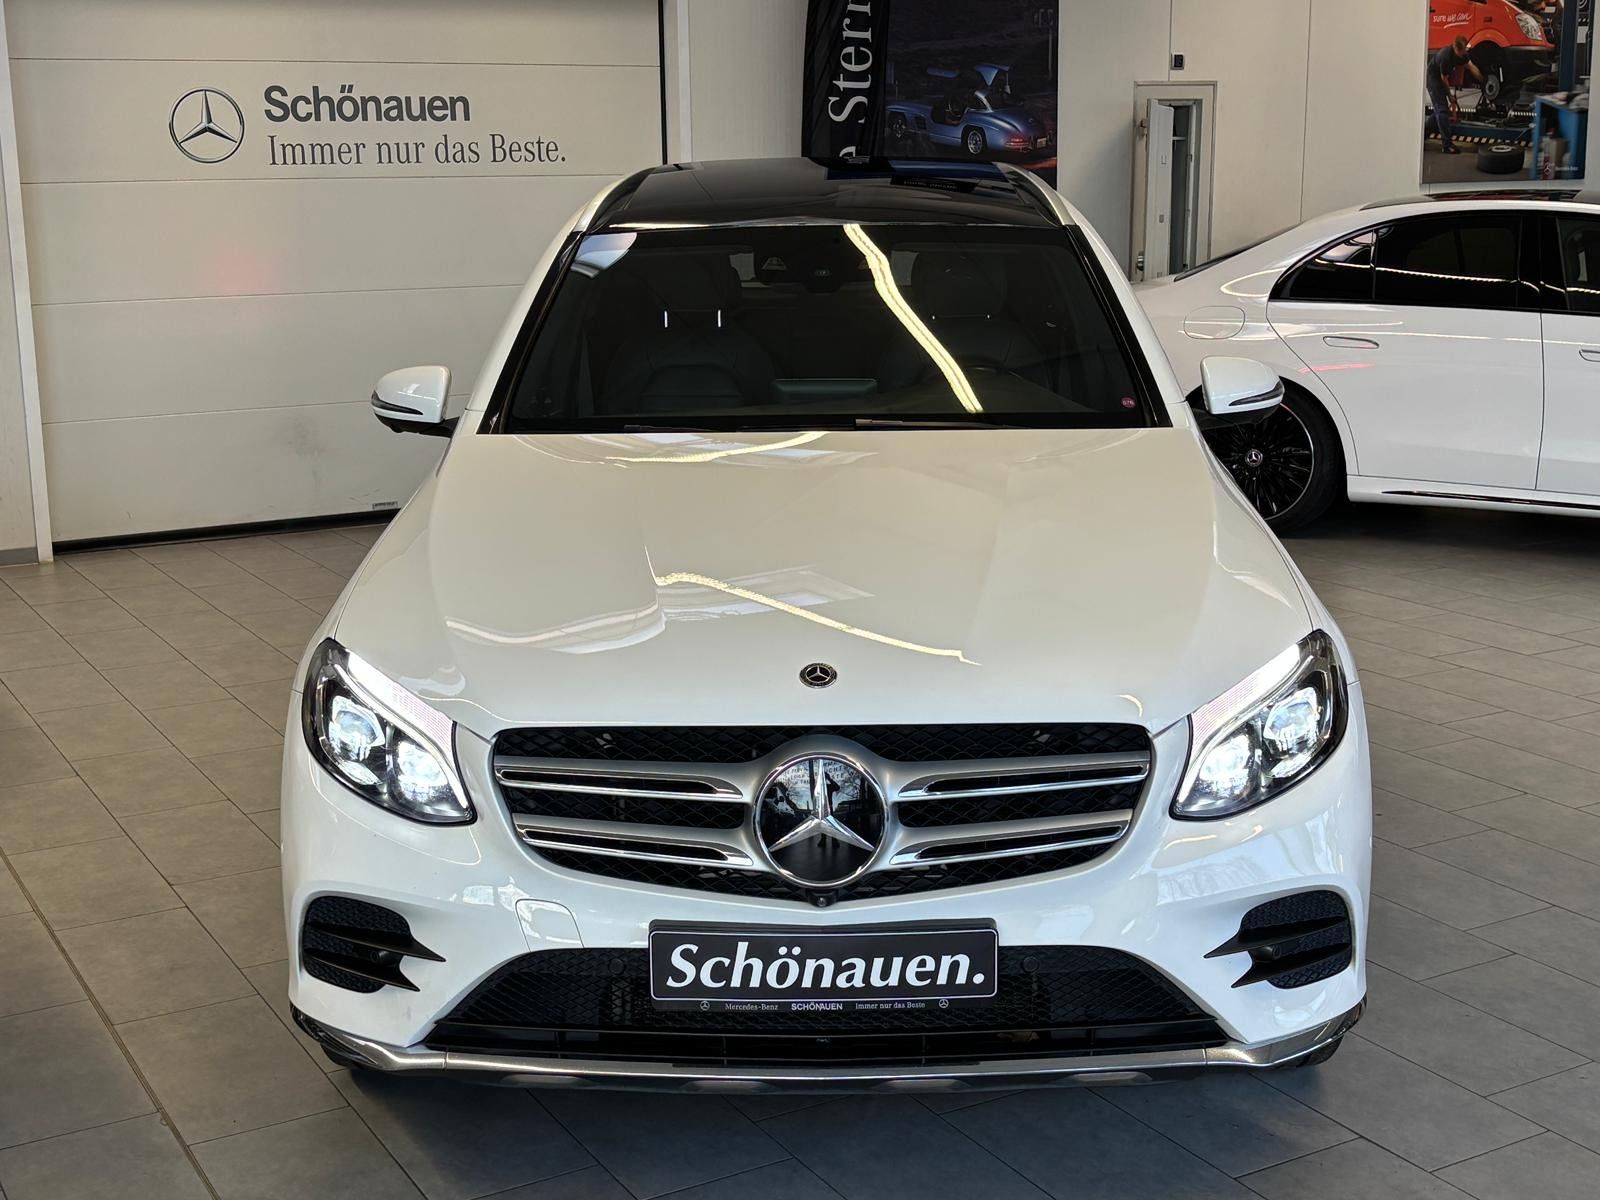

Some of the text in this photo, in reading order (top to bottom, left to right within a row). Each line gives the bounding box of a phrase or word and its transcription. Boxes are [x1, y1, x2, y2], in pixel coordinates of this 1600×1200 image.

[263, 84, 471, 123] Schönauen
[267, 132, 567, 166] Immer nur das Beste.
[666, 941, 986, 989] Schönauen.
[724, 1002, 779, 1012] Mercedes-Benz
[791, 1001, 843, 1012] SCHÖNAUEN
[855, 1002, 878, 1010] Immer
[893, 1001, 906, 1009] das
